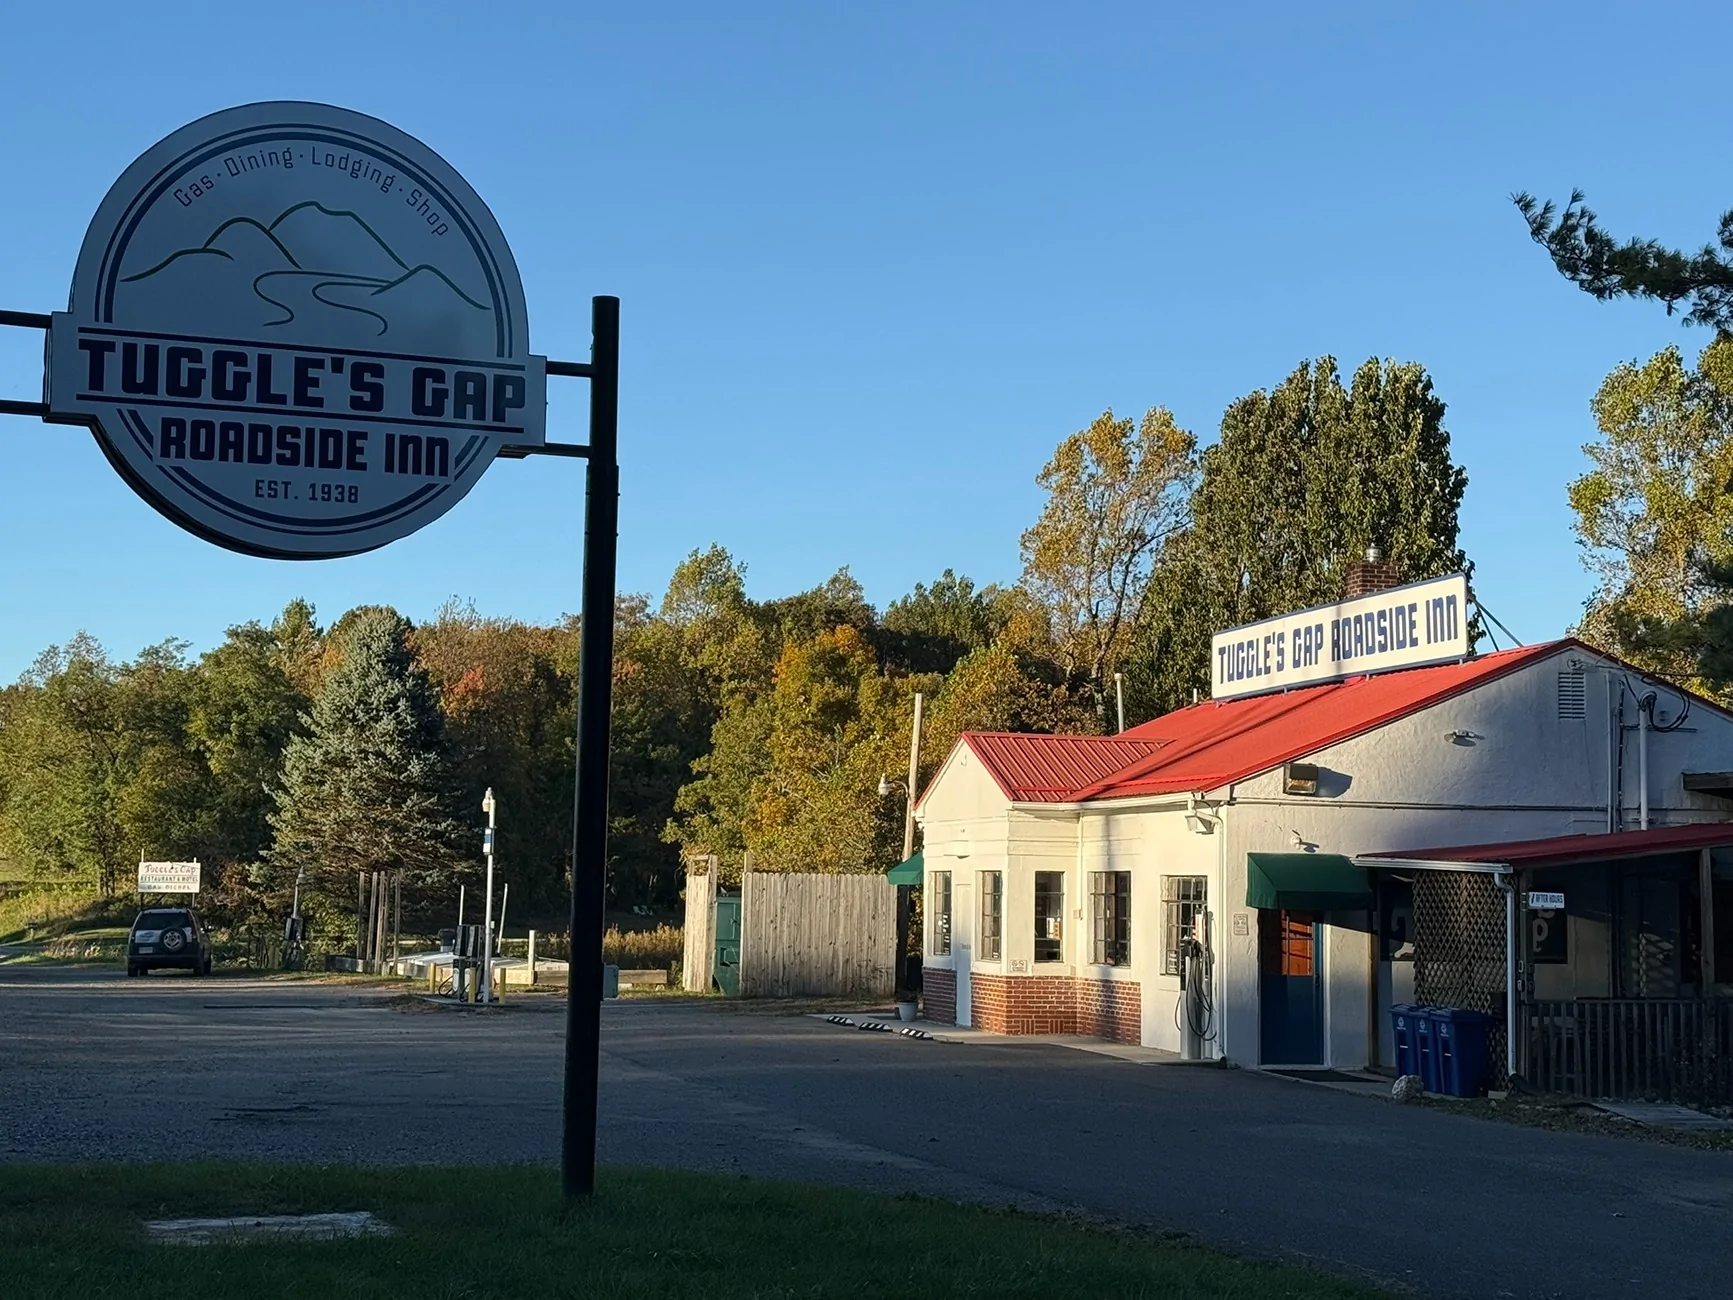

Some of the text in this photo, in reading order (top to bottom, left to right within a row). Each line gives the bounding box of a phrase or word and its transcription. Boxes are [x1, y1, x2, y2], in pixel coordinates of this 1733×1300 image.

[173, 146, 449, 236] Gas Dining Lodging Shop
[78, 338, 526, 423] TUGGLE'S GAP
[160, 416, 369, 472] ROADSIDE
[254, 479, 359, 503] EST. 1938
[1218, 631, 1285, 685] TUGGLE'S
[1292, 623, 1323, 669] GAP
[1331, 602, 1419, 663] ROADSIDE
